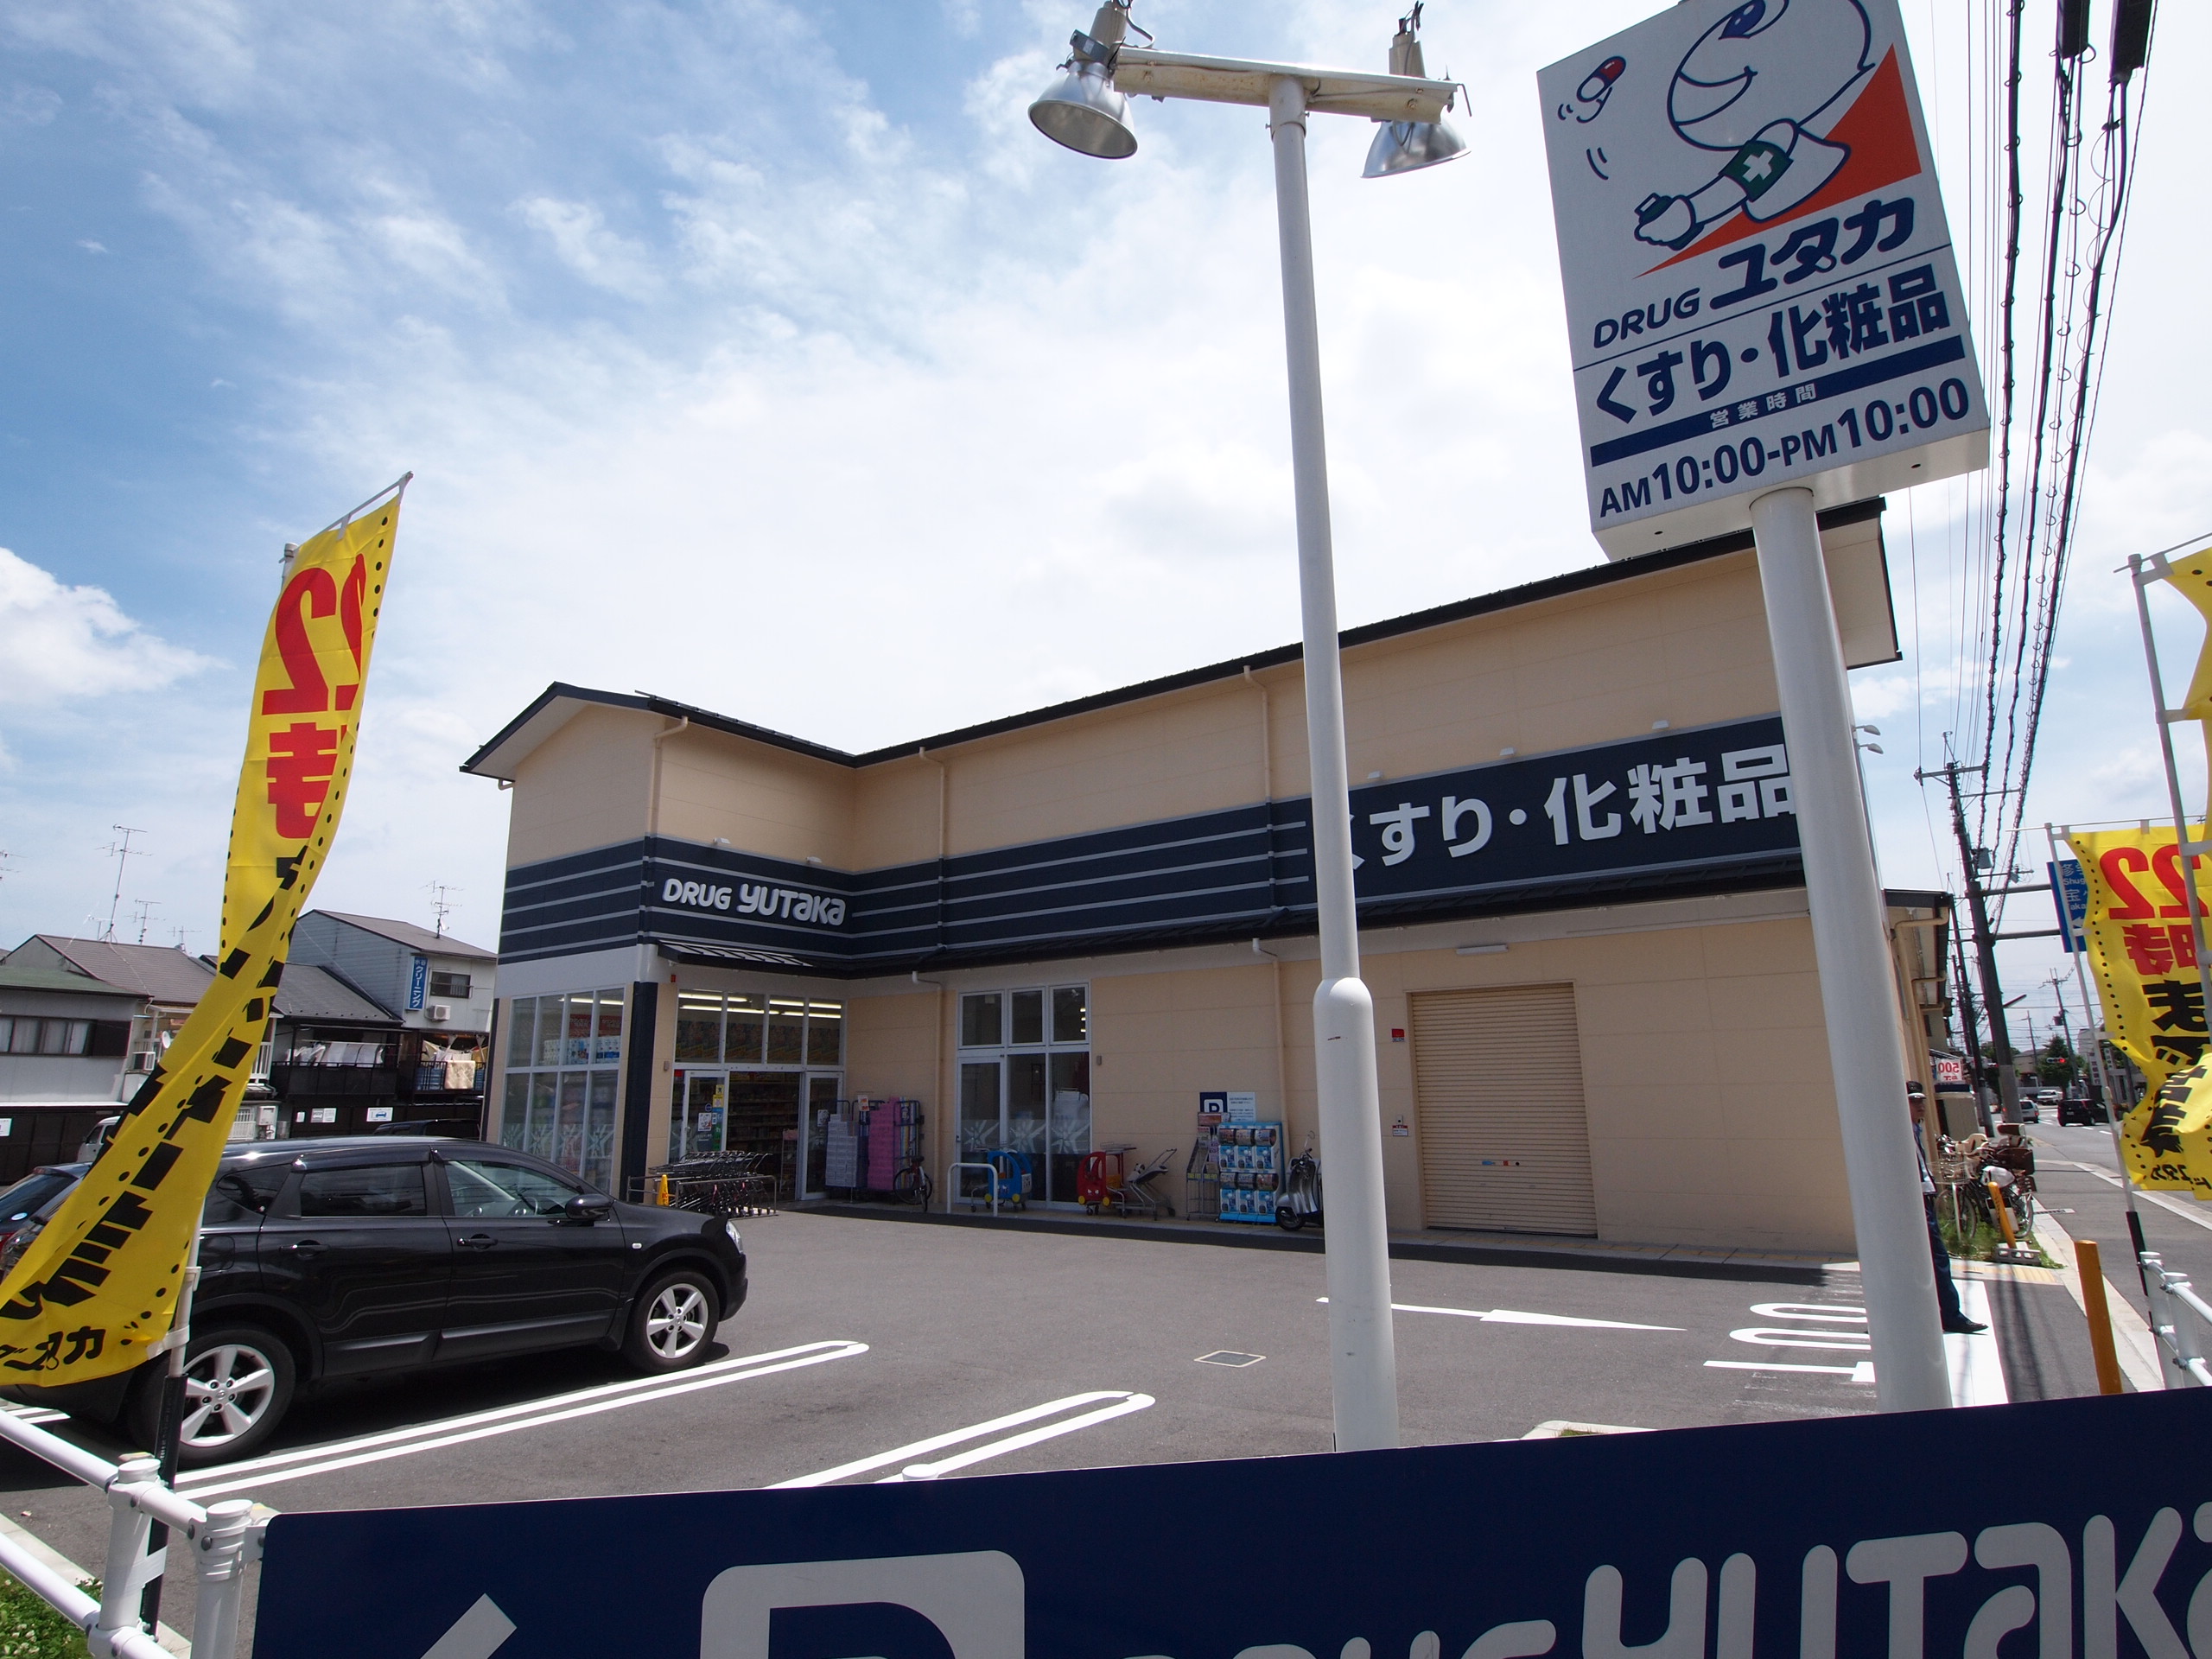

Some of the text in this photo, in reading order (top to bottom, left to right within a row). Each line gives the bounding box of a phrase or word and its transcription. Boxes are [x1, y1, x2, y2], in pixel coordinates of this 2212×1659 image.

[1592, 197, 1916, 349] DRUG ユタカ
[1594, 263, 1951, 425] くすり・化粧品
[1709, 383, 1817, 429] 営業時間
[662, 878, 732, 911] DRUG
[413, 966, 423, 1007] クリーニング
